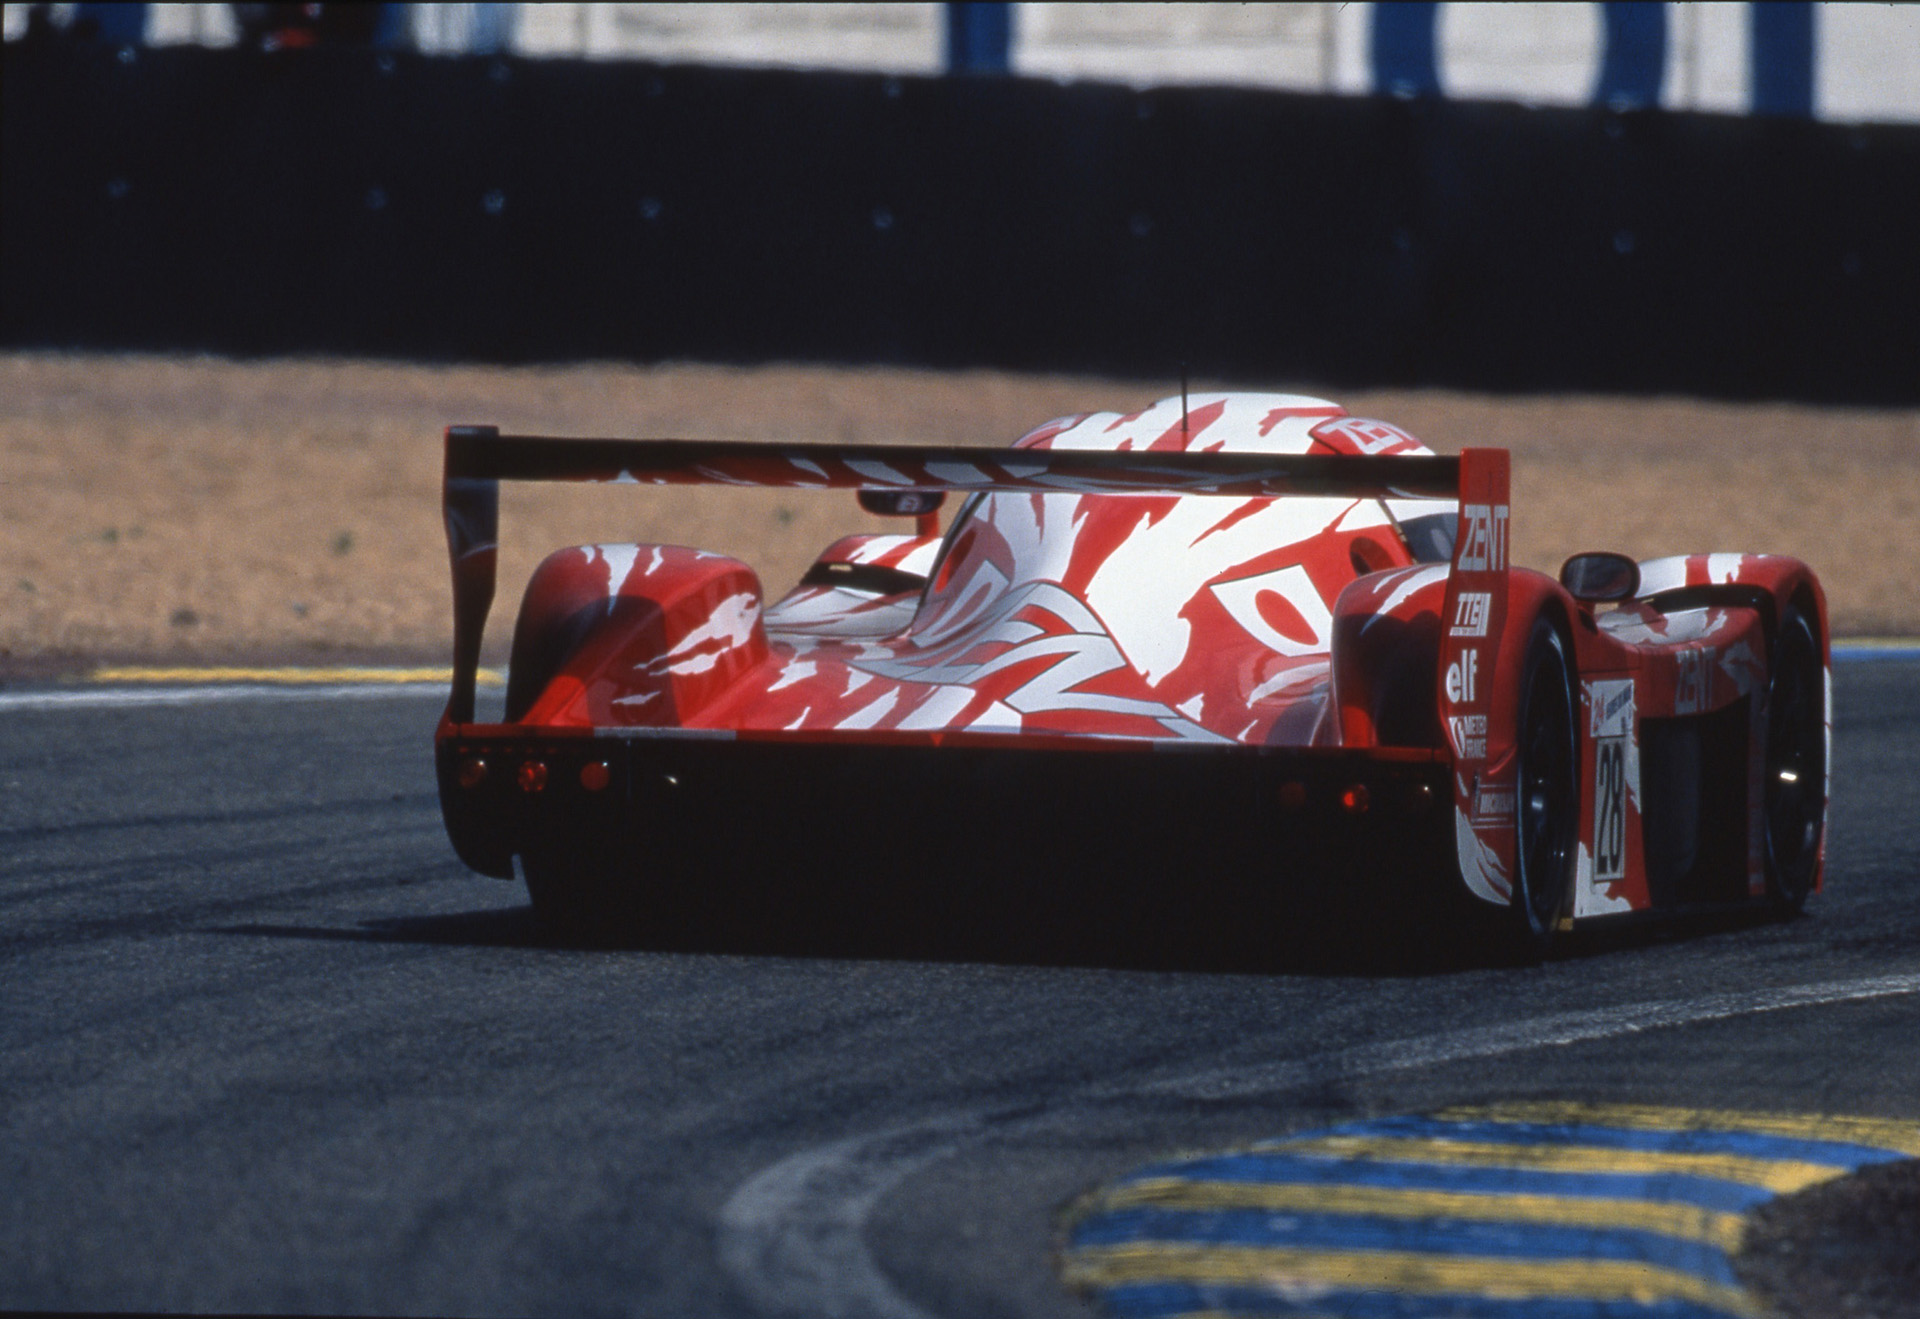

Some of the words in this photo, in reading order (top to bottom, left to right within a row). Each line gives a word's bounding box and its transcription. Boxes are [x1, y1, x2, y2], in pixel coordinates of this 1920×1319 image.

[1457, 504, 1508, 571] ZENT
[1446, 649, 1477, 703] elf
[1675, 646, 1716, 715] ZENT
[1597, 742, 1622, 874] 28
